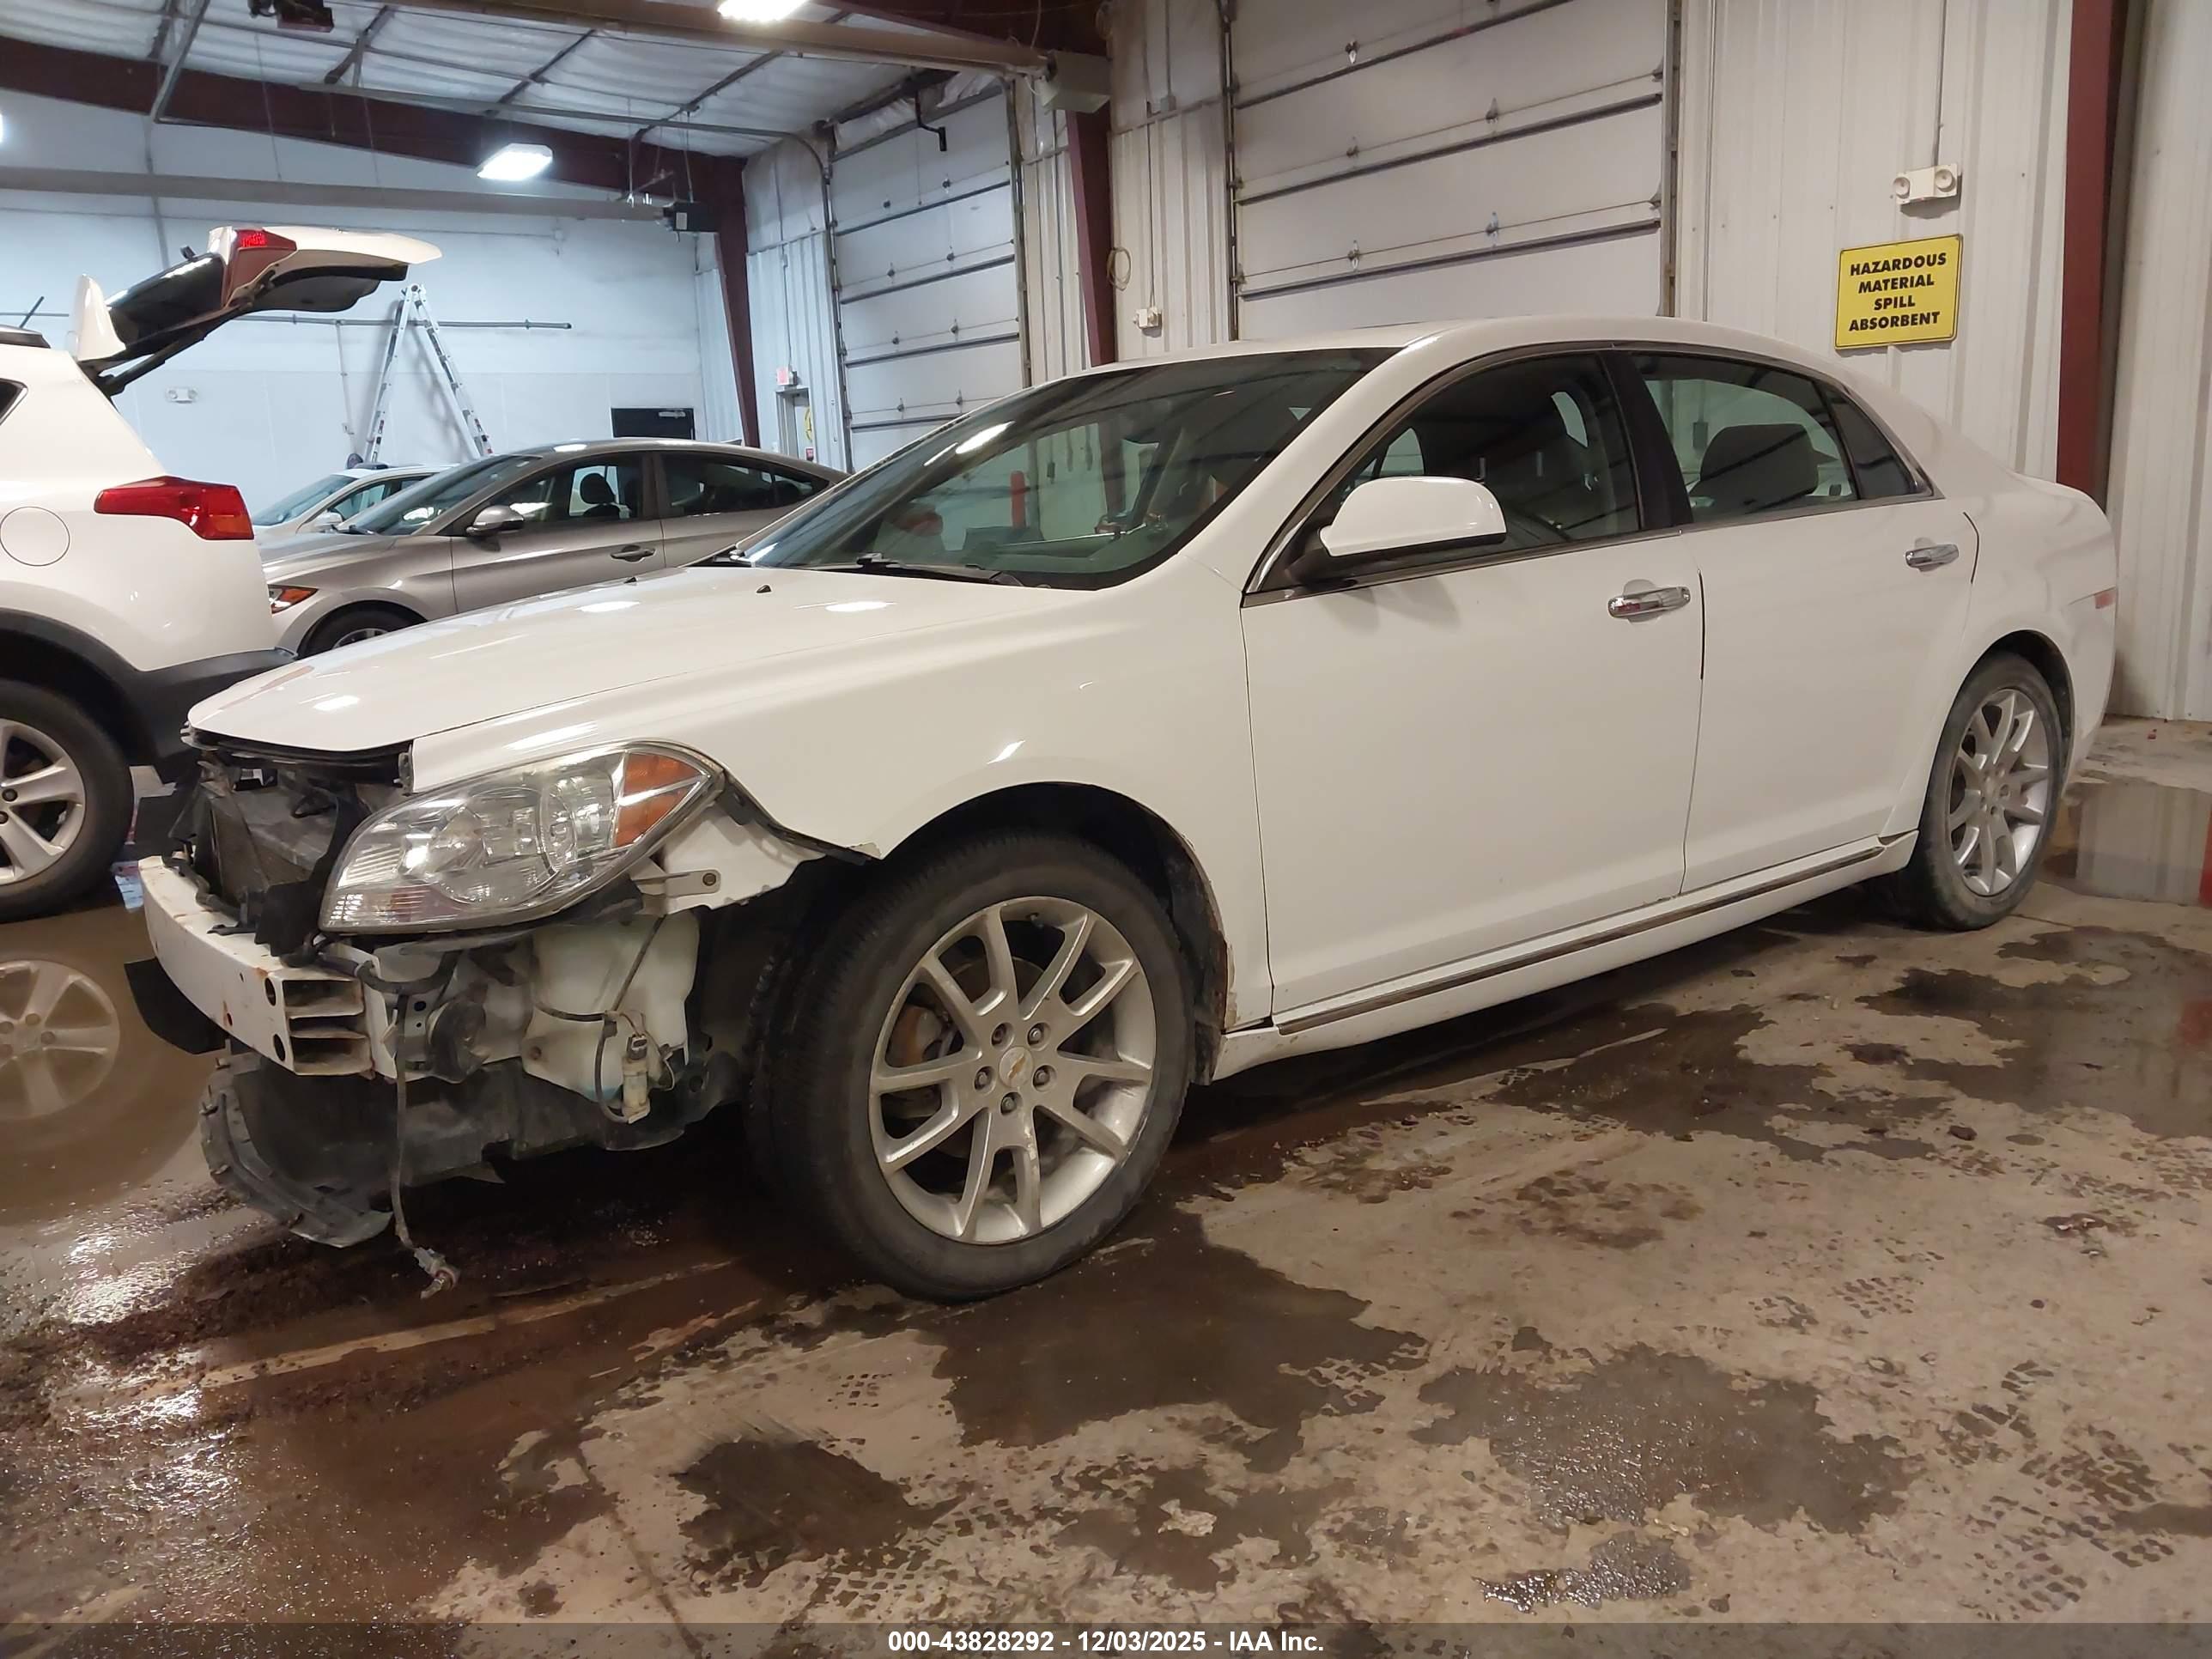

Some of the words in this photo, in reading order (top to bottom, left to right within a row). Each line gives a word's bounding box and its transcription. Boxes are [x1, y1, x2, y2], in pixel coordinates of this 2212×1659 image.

[1850, 252, 1947, 276] HAZARDOUS
[1858, 273, 1935, 294] MATERIAL
[1874, 295, 1916, 311] SPILL
[1848, 311, 1941, 331] ABSORBENT
